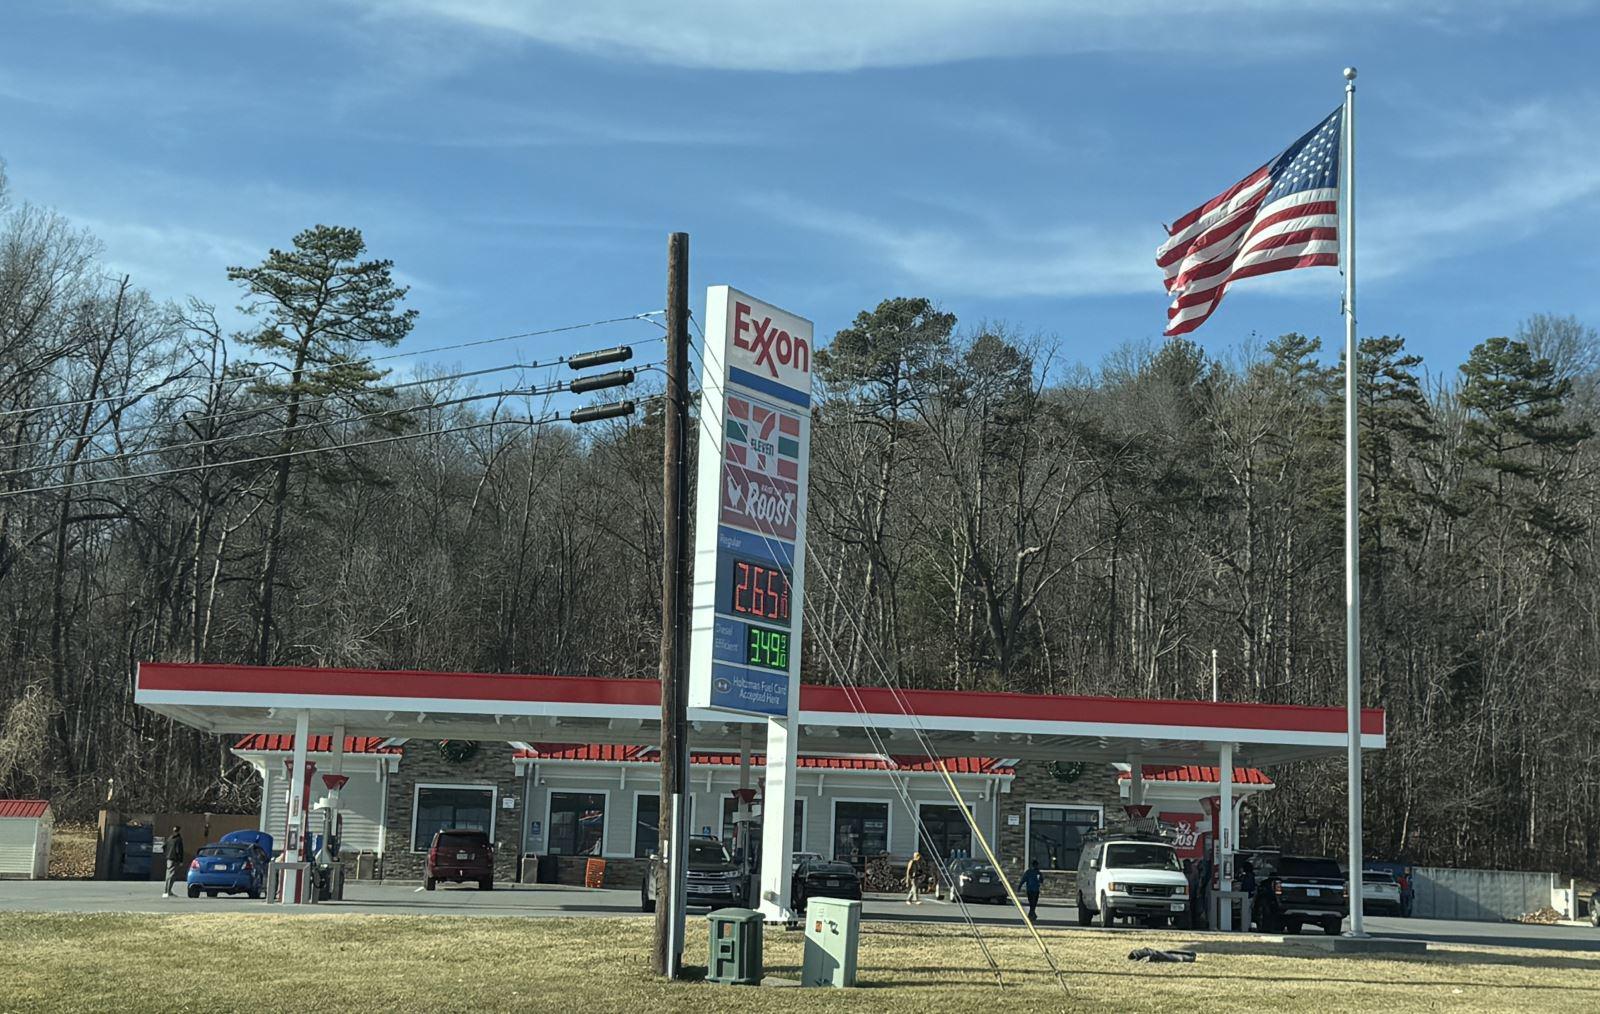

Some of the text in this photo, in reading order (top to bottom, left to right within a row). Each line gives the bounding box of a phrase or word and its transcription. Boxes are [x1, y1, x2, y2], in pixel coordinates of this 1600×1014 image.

[745, 481, 796, 527] ROOST
[739, 688, 780, 705] Accepted Here
[761, 681, 774, 693] Fuel
[774, 683, 787, 695] Card
